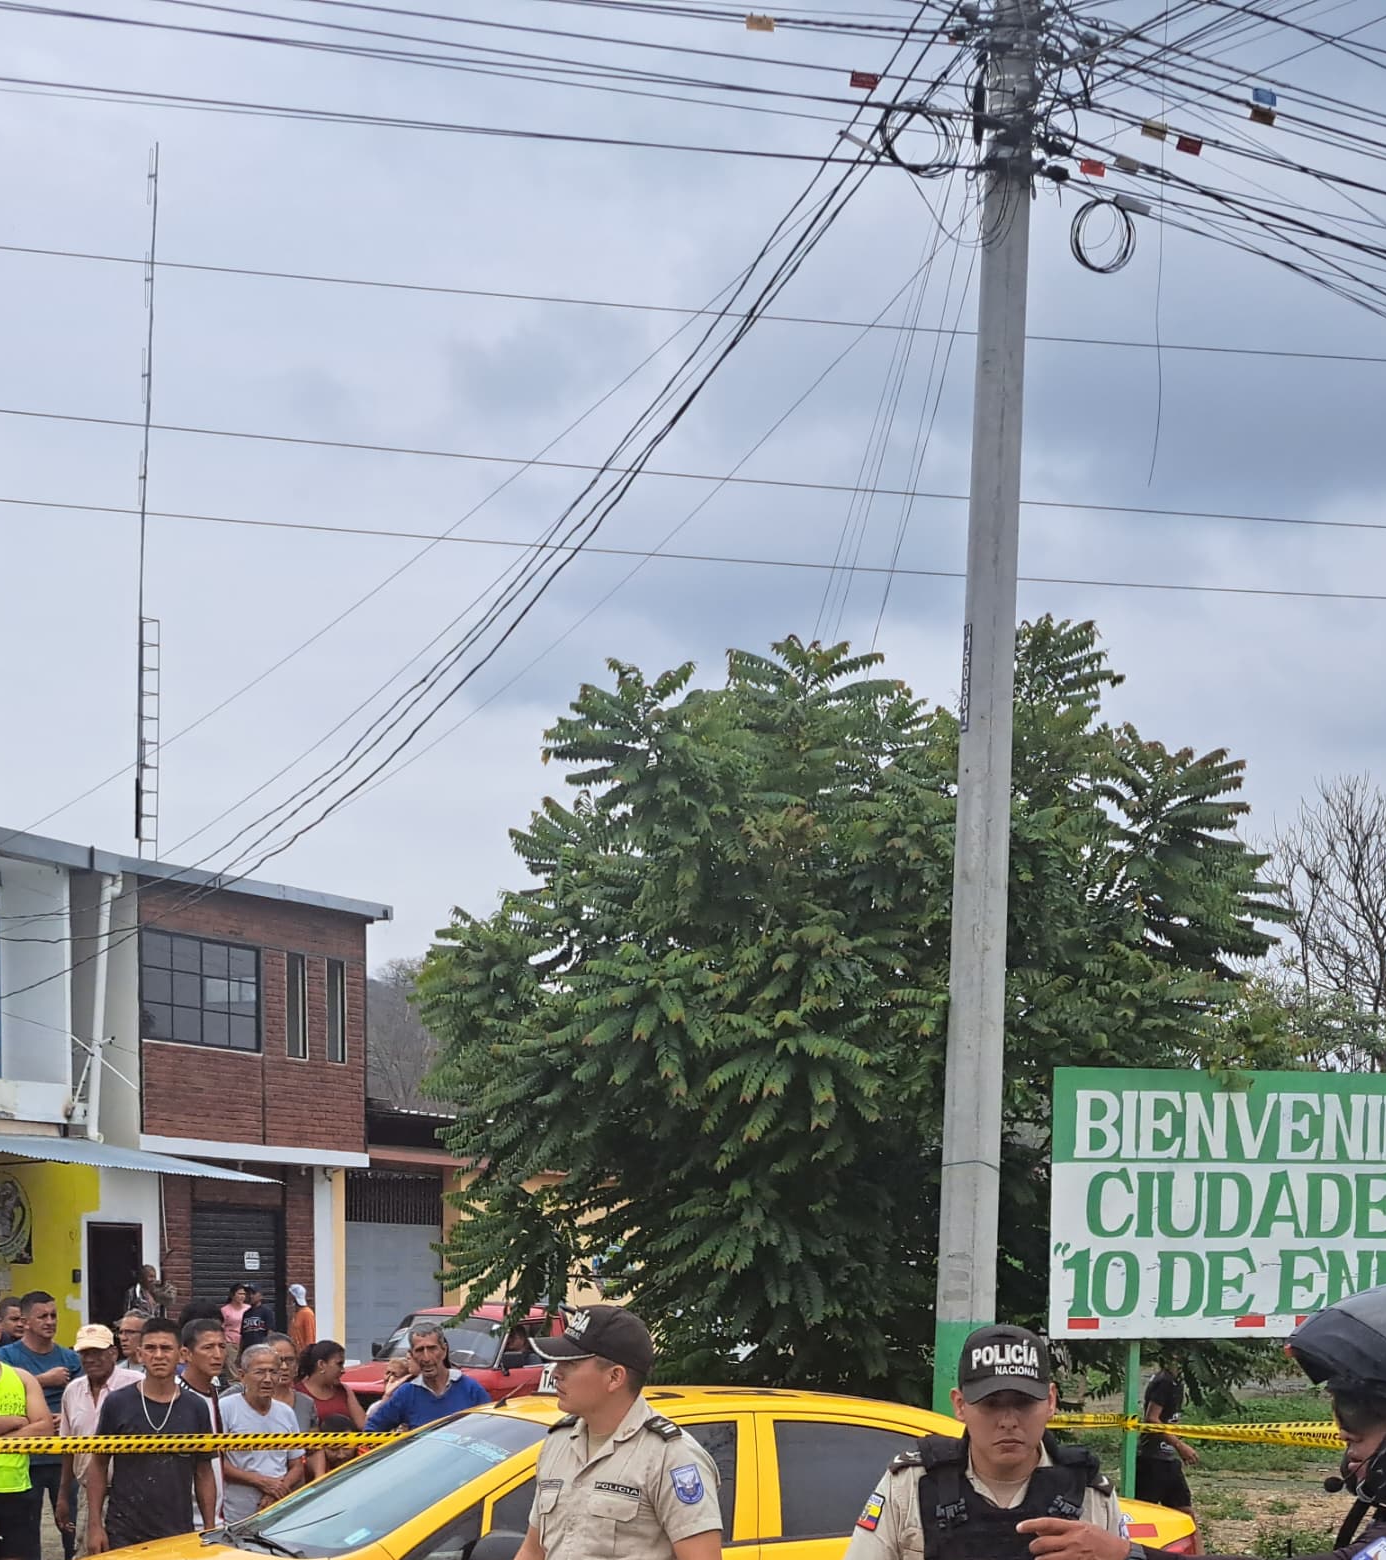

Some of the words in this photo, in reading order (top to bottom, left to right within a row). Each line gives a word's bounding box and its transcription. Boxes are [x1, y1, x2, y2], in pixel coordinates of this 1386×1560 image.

[1155, 1247, 1256, 1318] DE
[972, 1339, 1039, 1370] POLICÍA
[995, 1365, 1039, 1379] NACIONAL
[596, 1482, 639, 1496] POLICIA
